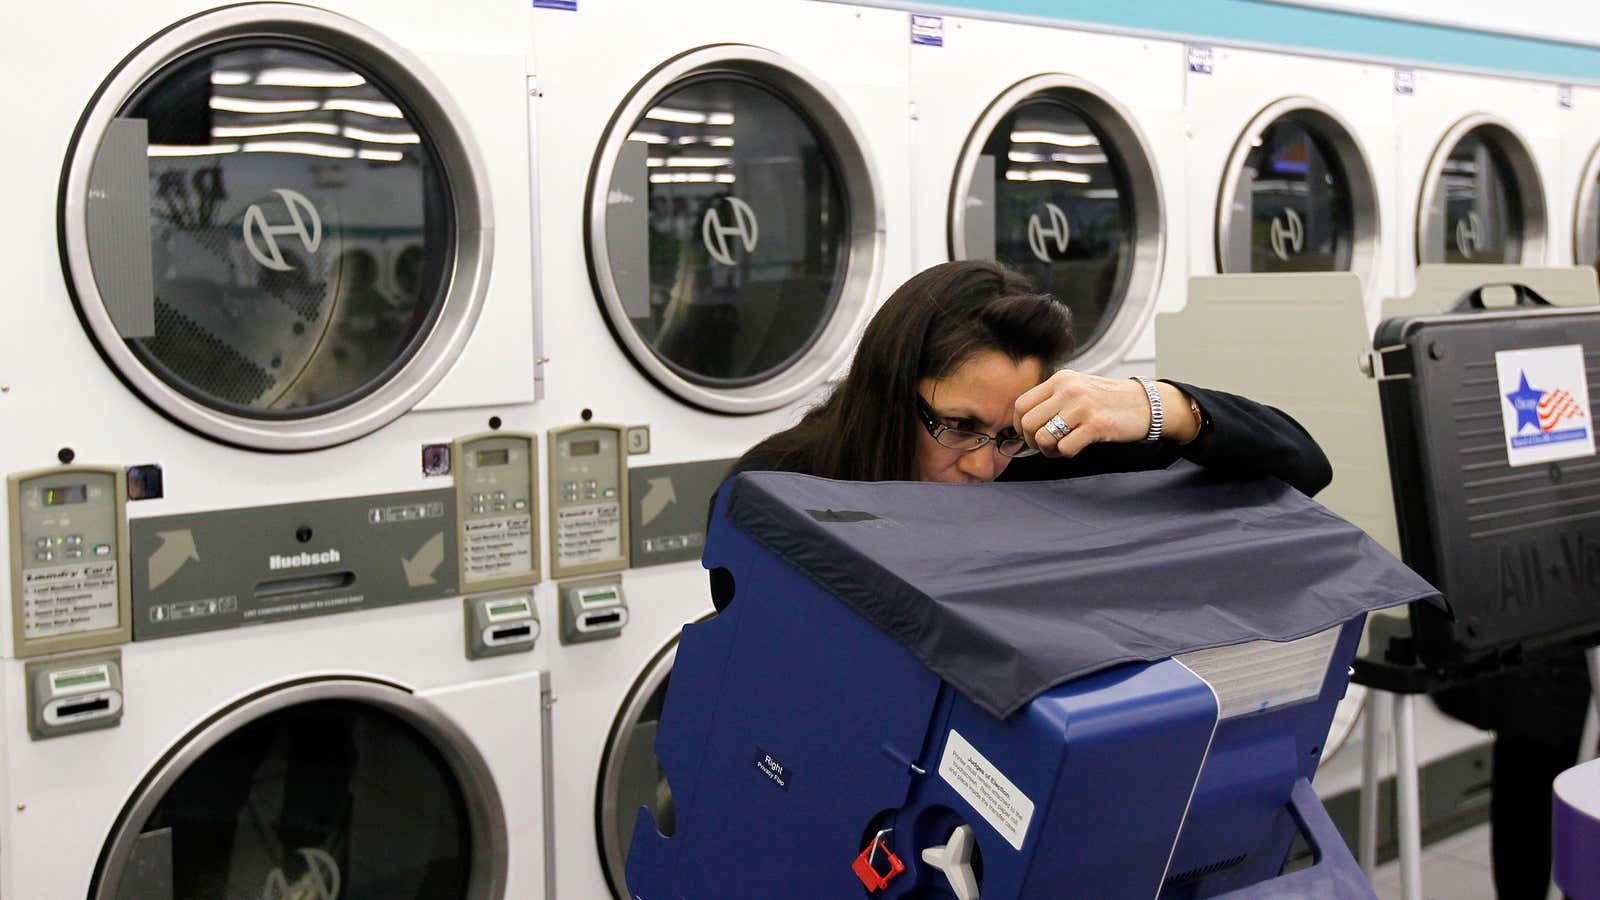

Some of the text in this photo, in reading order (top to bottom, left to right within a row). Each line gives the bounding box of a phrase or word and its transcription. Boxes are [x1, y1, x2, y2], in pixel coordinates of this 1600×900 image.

[633, 433, 641, 448] 3
[433, 454, 441, 467] 2
[269, 548, 340, 571] Huebsch
[757, 761, 785, 786] Privacy Flap
[765, 755, 783, 775] Right
[968, 756, 985, 775] Judges
[985, 772, 992, 780] of
